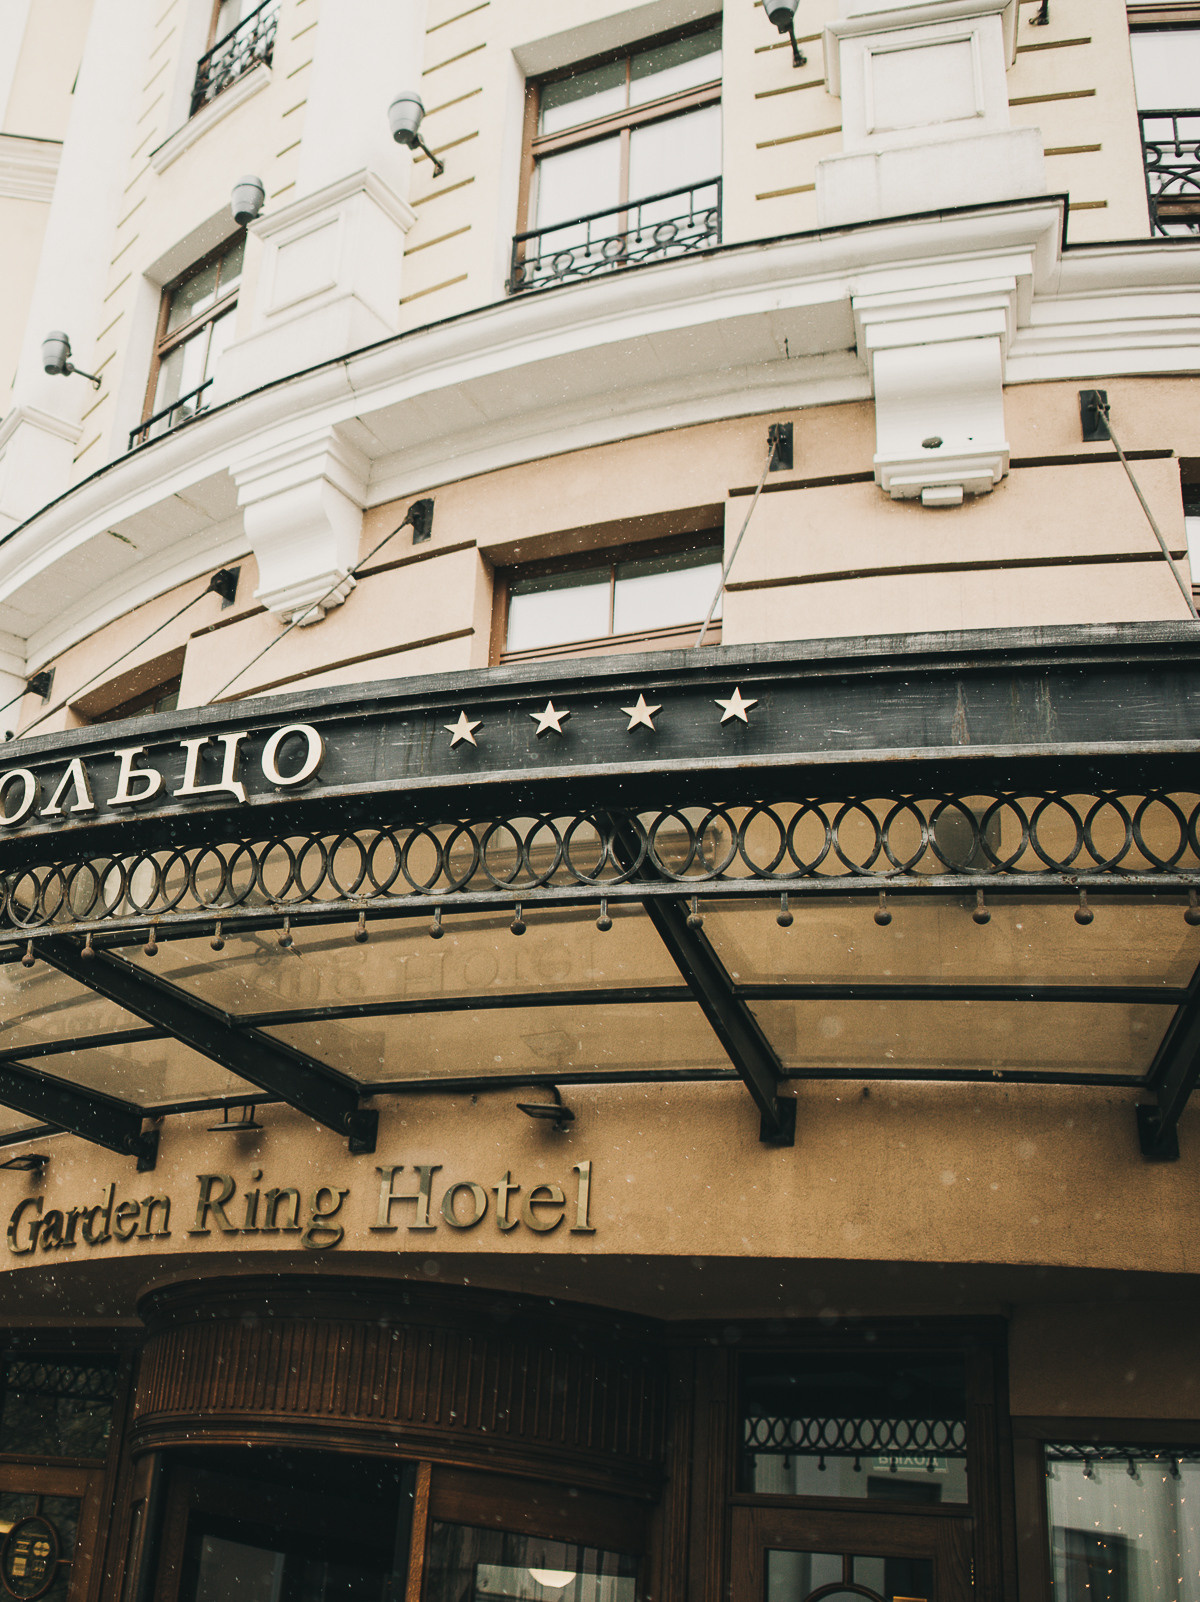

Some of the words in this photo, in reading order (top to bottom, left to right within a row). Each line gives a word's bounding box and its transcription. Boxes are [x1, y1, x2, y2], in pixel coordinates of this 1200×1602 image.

[6, 1182, 172, 1255] Garden
[187, 1169, 350, 1250] Ring
[369, 1160, 597, 1235] Hotel
